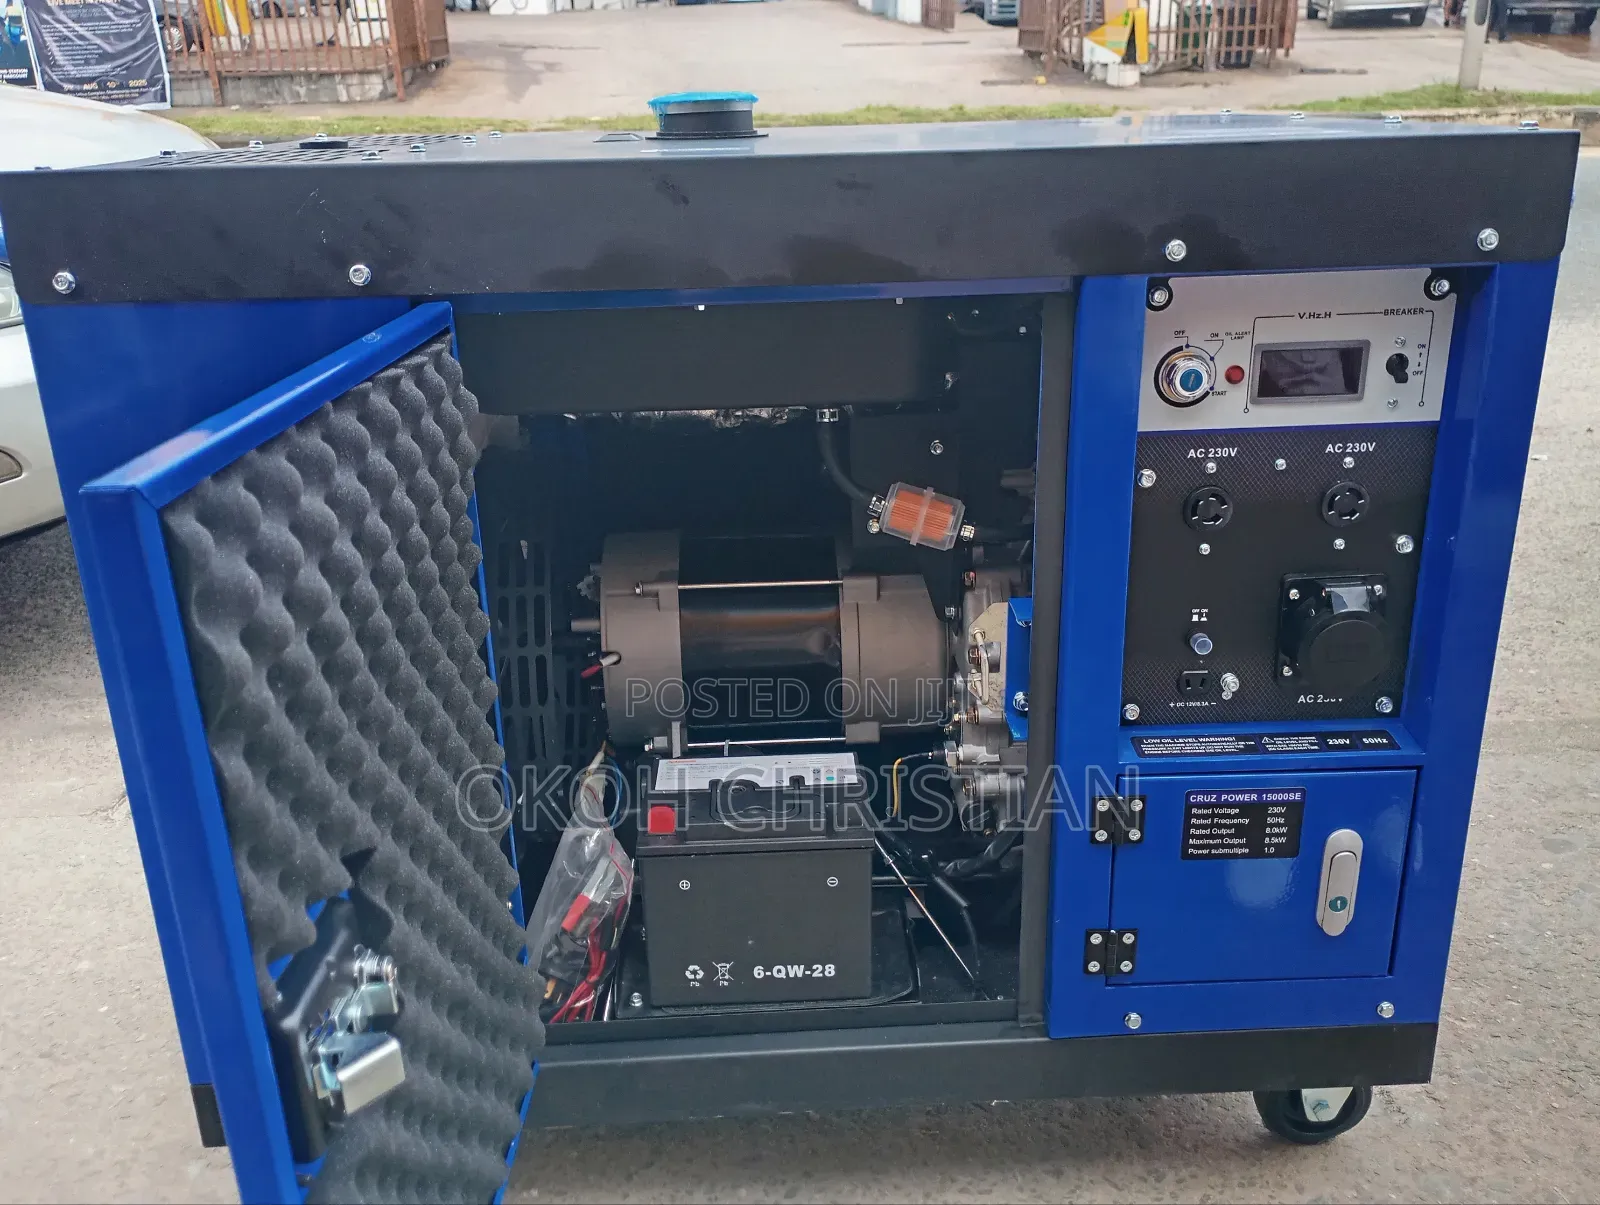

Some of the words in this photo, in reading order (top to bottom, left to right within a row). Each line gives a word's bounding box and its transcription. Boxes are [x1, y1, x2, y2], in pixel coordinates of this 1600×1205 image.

[1298, 311, 1332, 320] V.Hz.H
[1383, 308, 1424, 316] BREAKER
[1325, 443, 1343, 453] AC
[1346, 442, 1376, 452] 230V
[1188, 448, 1205, 458] AC
[1208, 448, 1237, 458] 230V
[1297, 694, 1314, 703] AC
[1262, 792, 1301, 801] 15000SE
[1214, 807, 1239, 815] Voltage
[1214, 817, 1250, 825] Frequency
[753, 964, 836, 979] 6-QW-28
